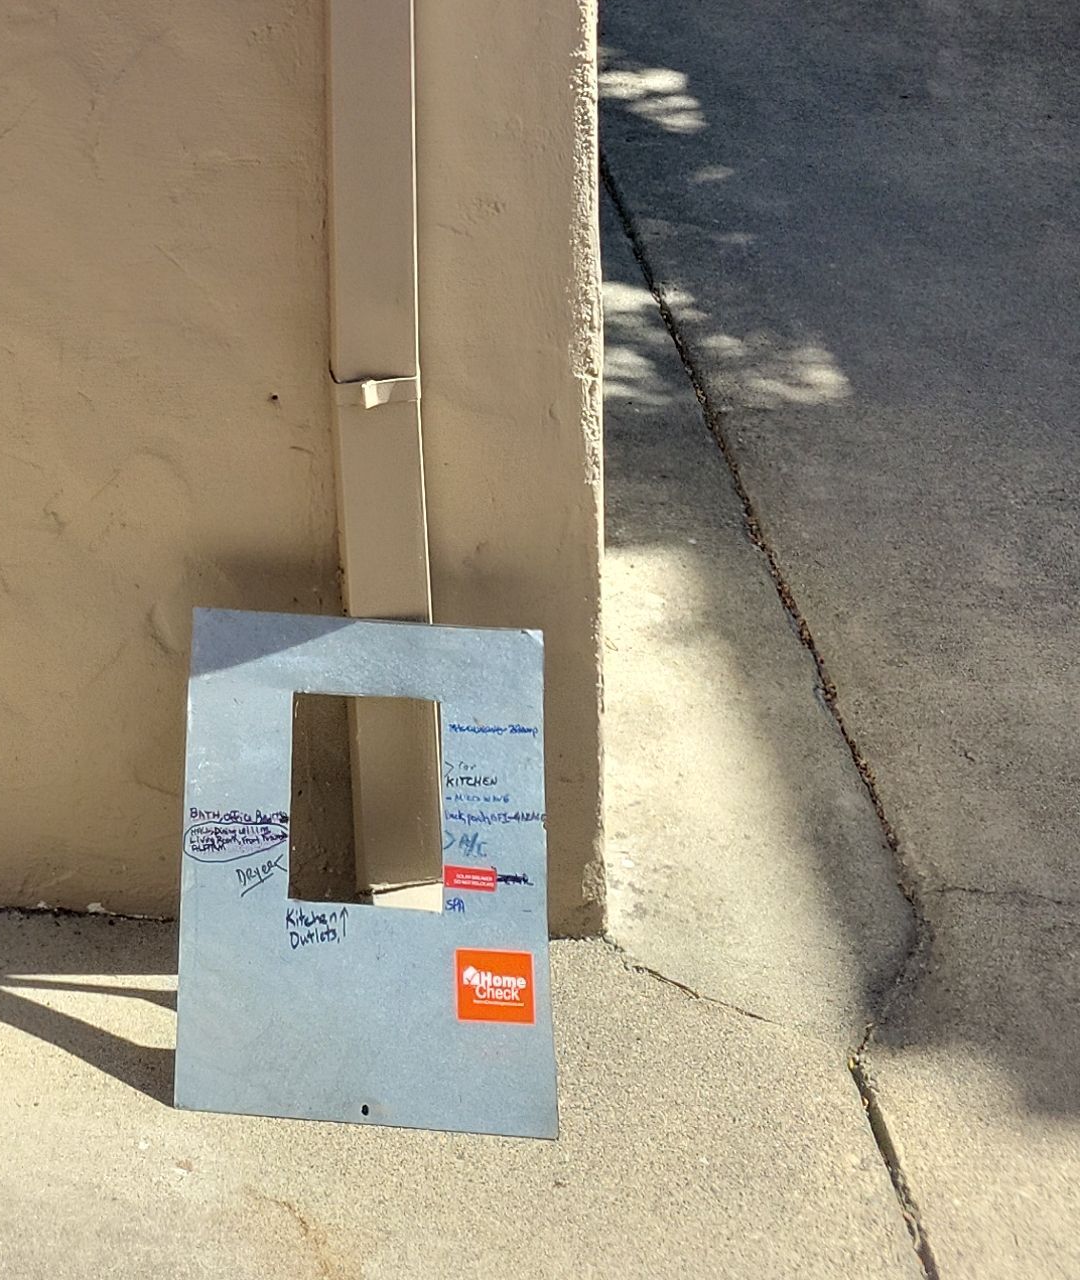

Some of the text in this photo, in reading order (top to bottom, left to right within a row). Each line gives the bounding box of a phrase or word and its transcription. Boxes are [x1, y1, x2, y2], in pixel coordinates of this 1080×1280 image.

[446, 776, 498, 788] KITCHEN
[286, 906, 337, 930] Kitchen
[480, 970, 527, 989] Home
[475, 984, 521, 1001] Check
